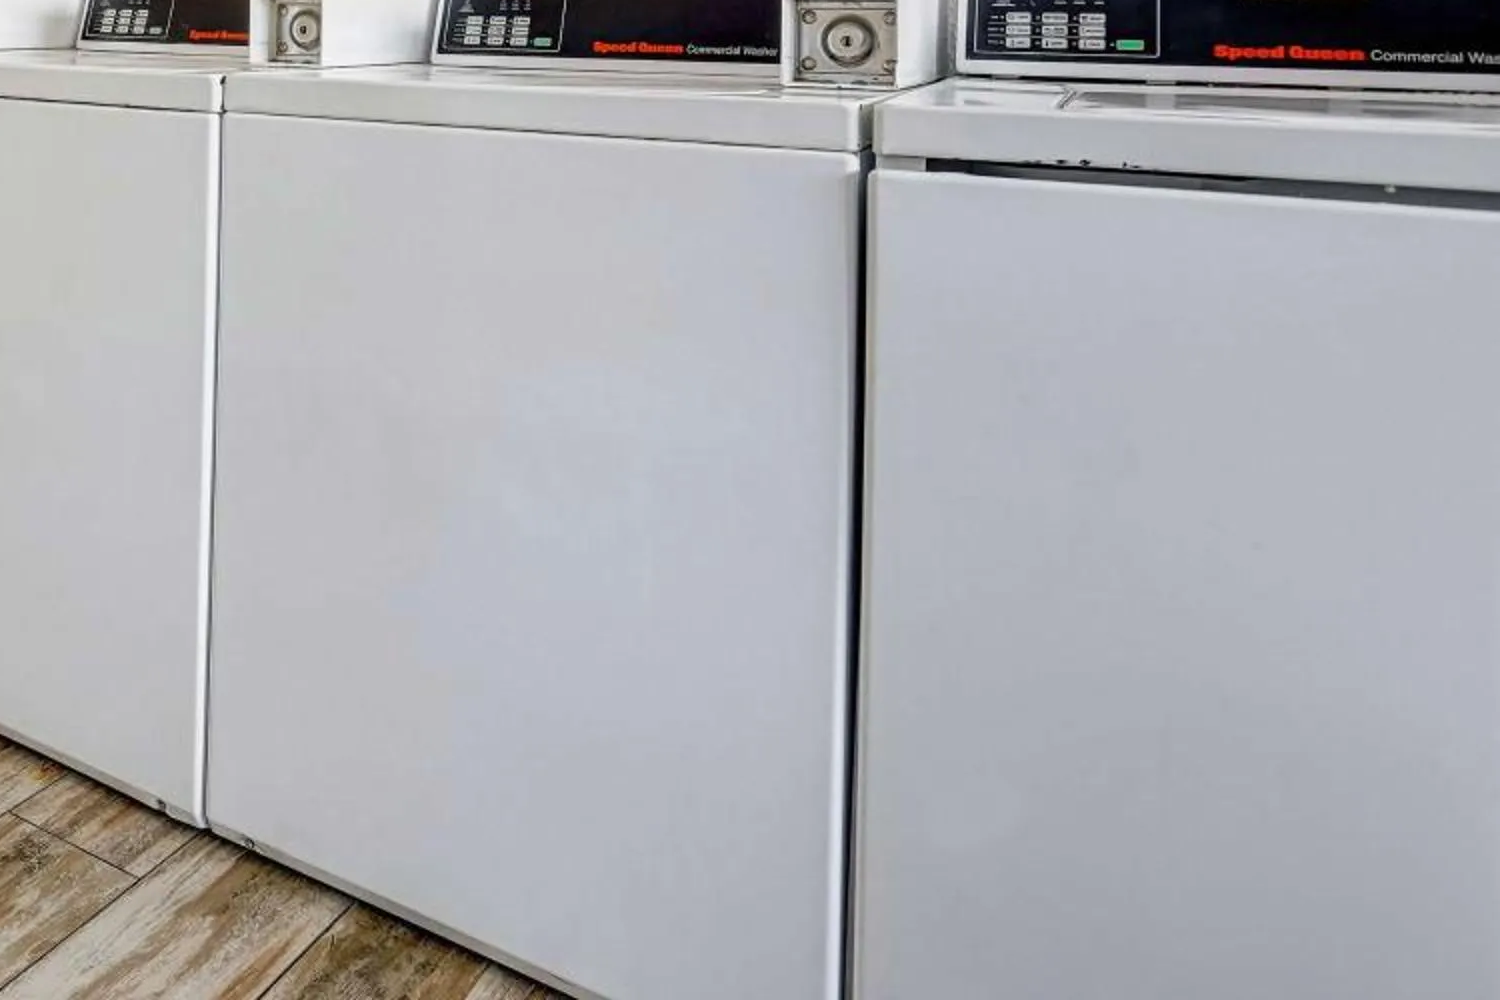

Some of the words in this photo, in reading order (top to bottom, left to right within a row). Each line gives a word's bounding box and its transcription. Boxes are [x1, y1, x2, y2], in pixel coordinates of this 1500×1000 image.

[593, 41, 636, 54] Speed
[638, 42, 684, 55] Queen
[1213, 44, 1285, 60] Speed
[1288, 45, 1365, 61] Queen
[1370, 49, 1464, 64] Commercial
